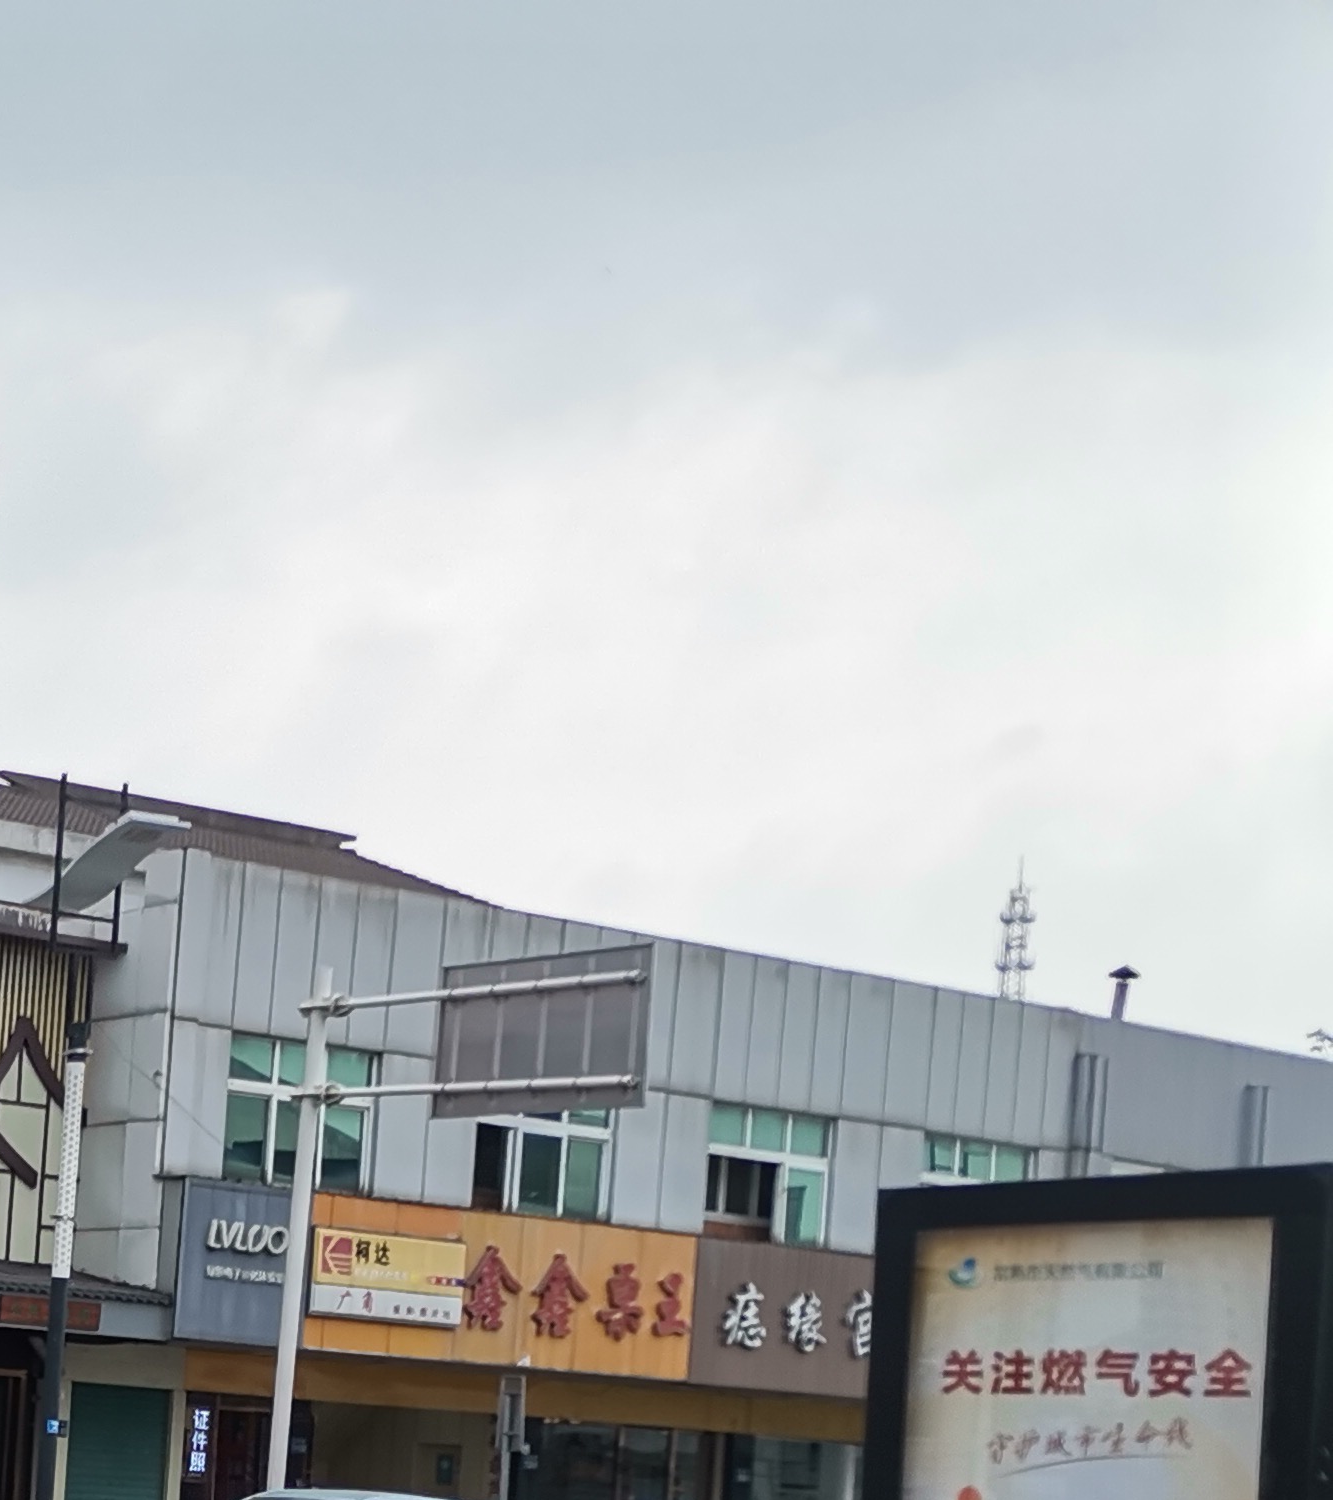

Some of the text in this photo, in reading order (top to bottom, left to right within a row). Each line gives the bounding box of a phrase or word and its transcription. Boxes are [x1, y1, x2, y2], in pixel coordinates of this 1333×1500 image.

[354, 1238, 391, 1267] 柯达
[941, 1348, 1253, 1399] 关注燃气安全
[188, 1408, 211, 1473] 证件照
